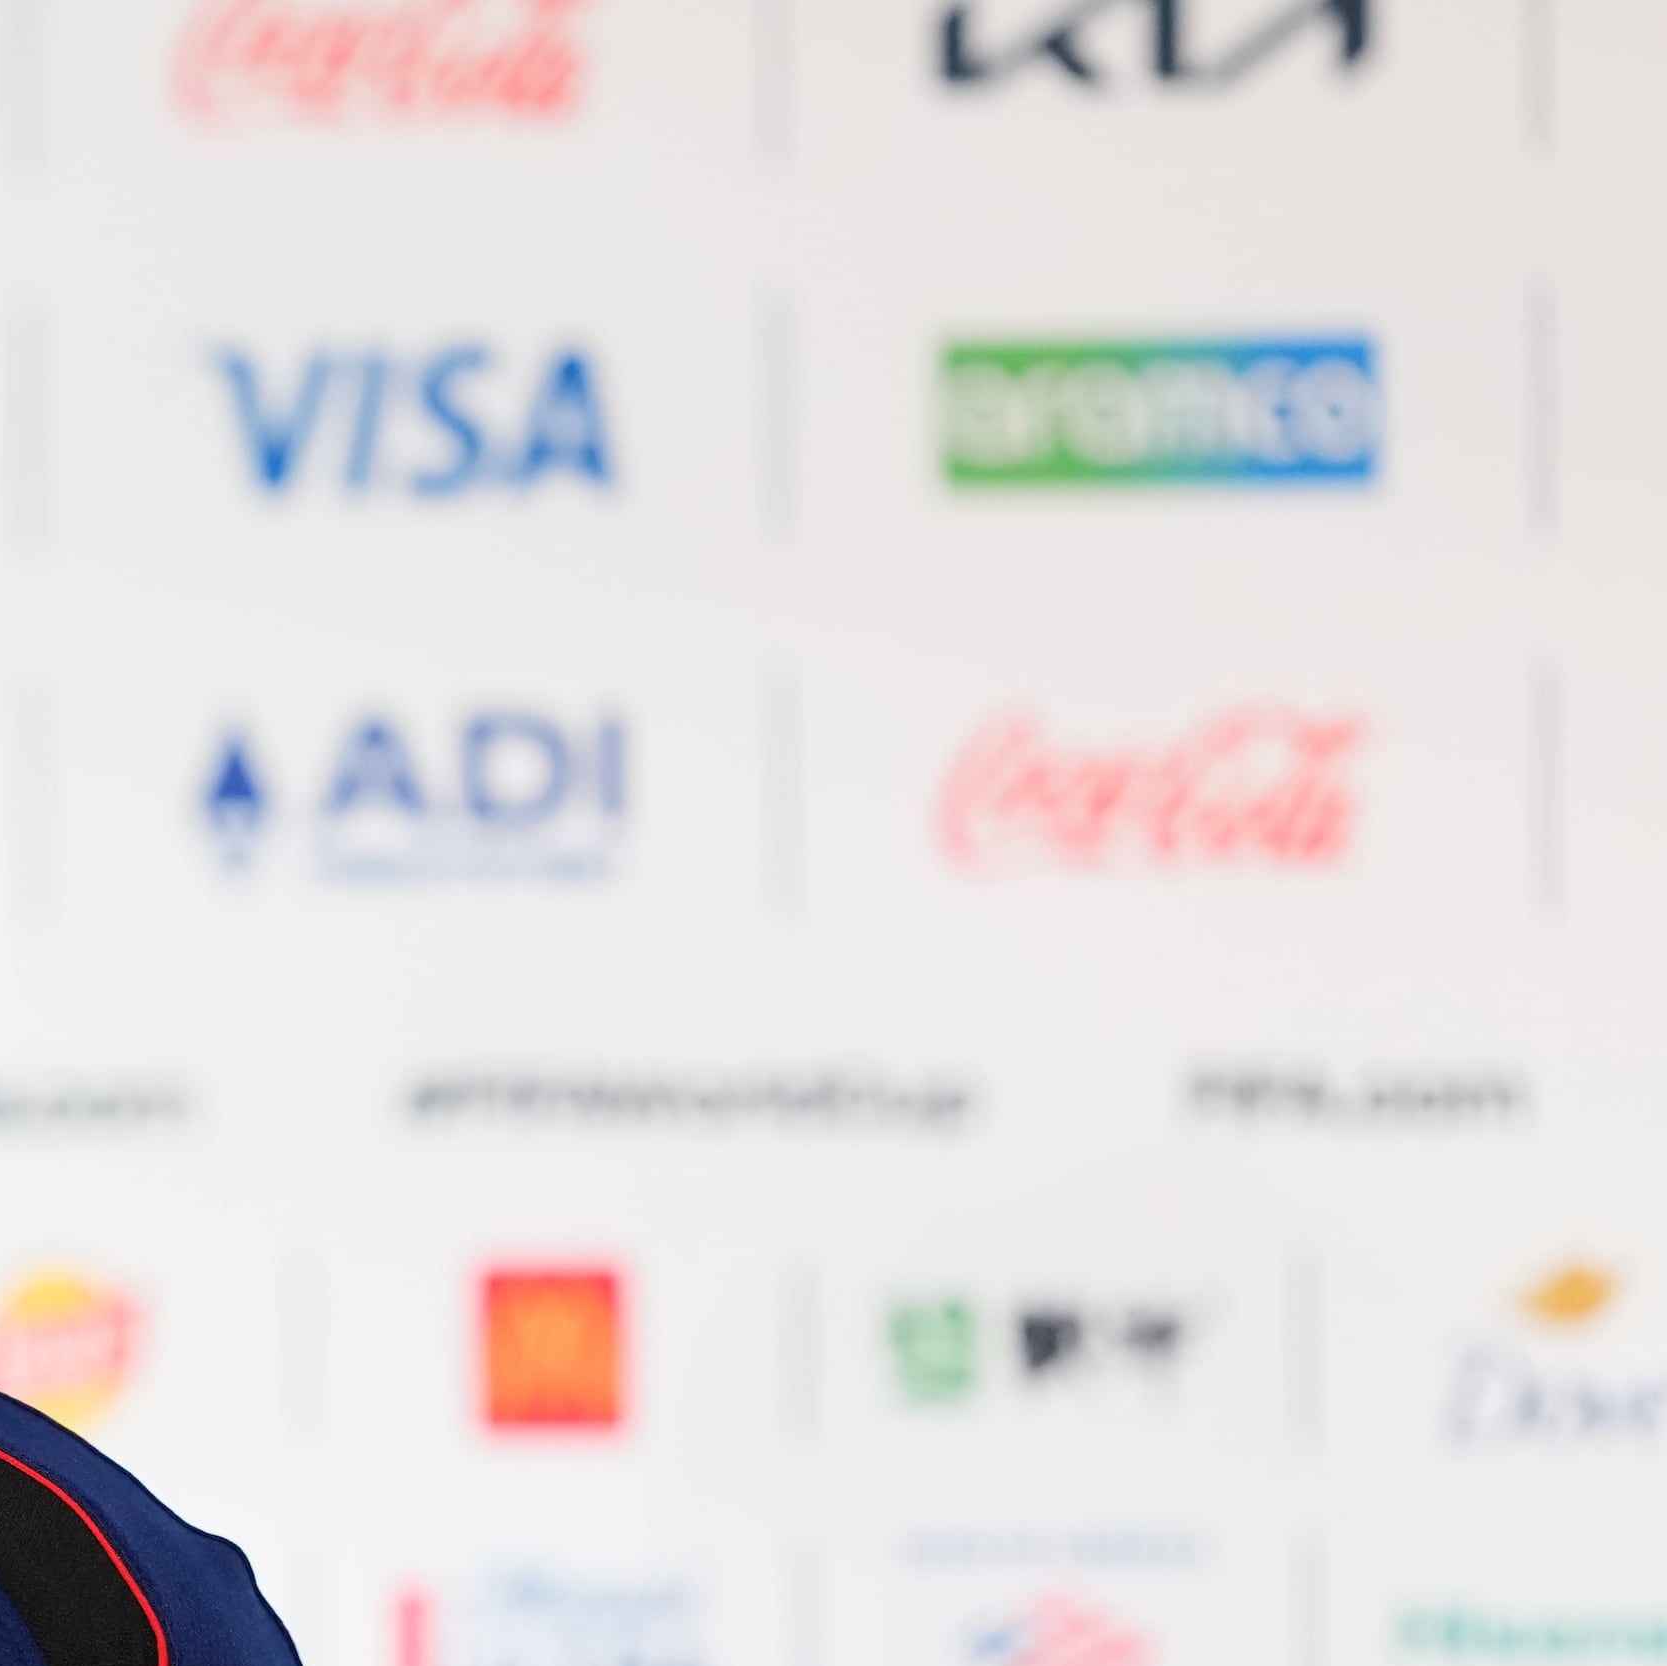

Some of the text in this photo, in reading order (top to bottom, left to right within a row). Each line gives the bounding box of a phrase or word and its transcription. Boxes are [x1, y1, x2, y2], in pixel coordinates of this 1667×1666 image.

[217, 342, 619, 500] VISA
[939, 355, 1373, 472] aramco
[317, 708, 629, 827] ADI
[937, 705, 1369, 870] Coca-Cola
